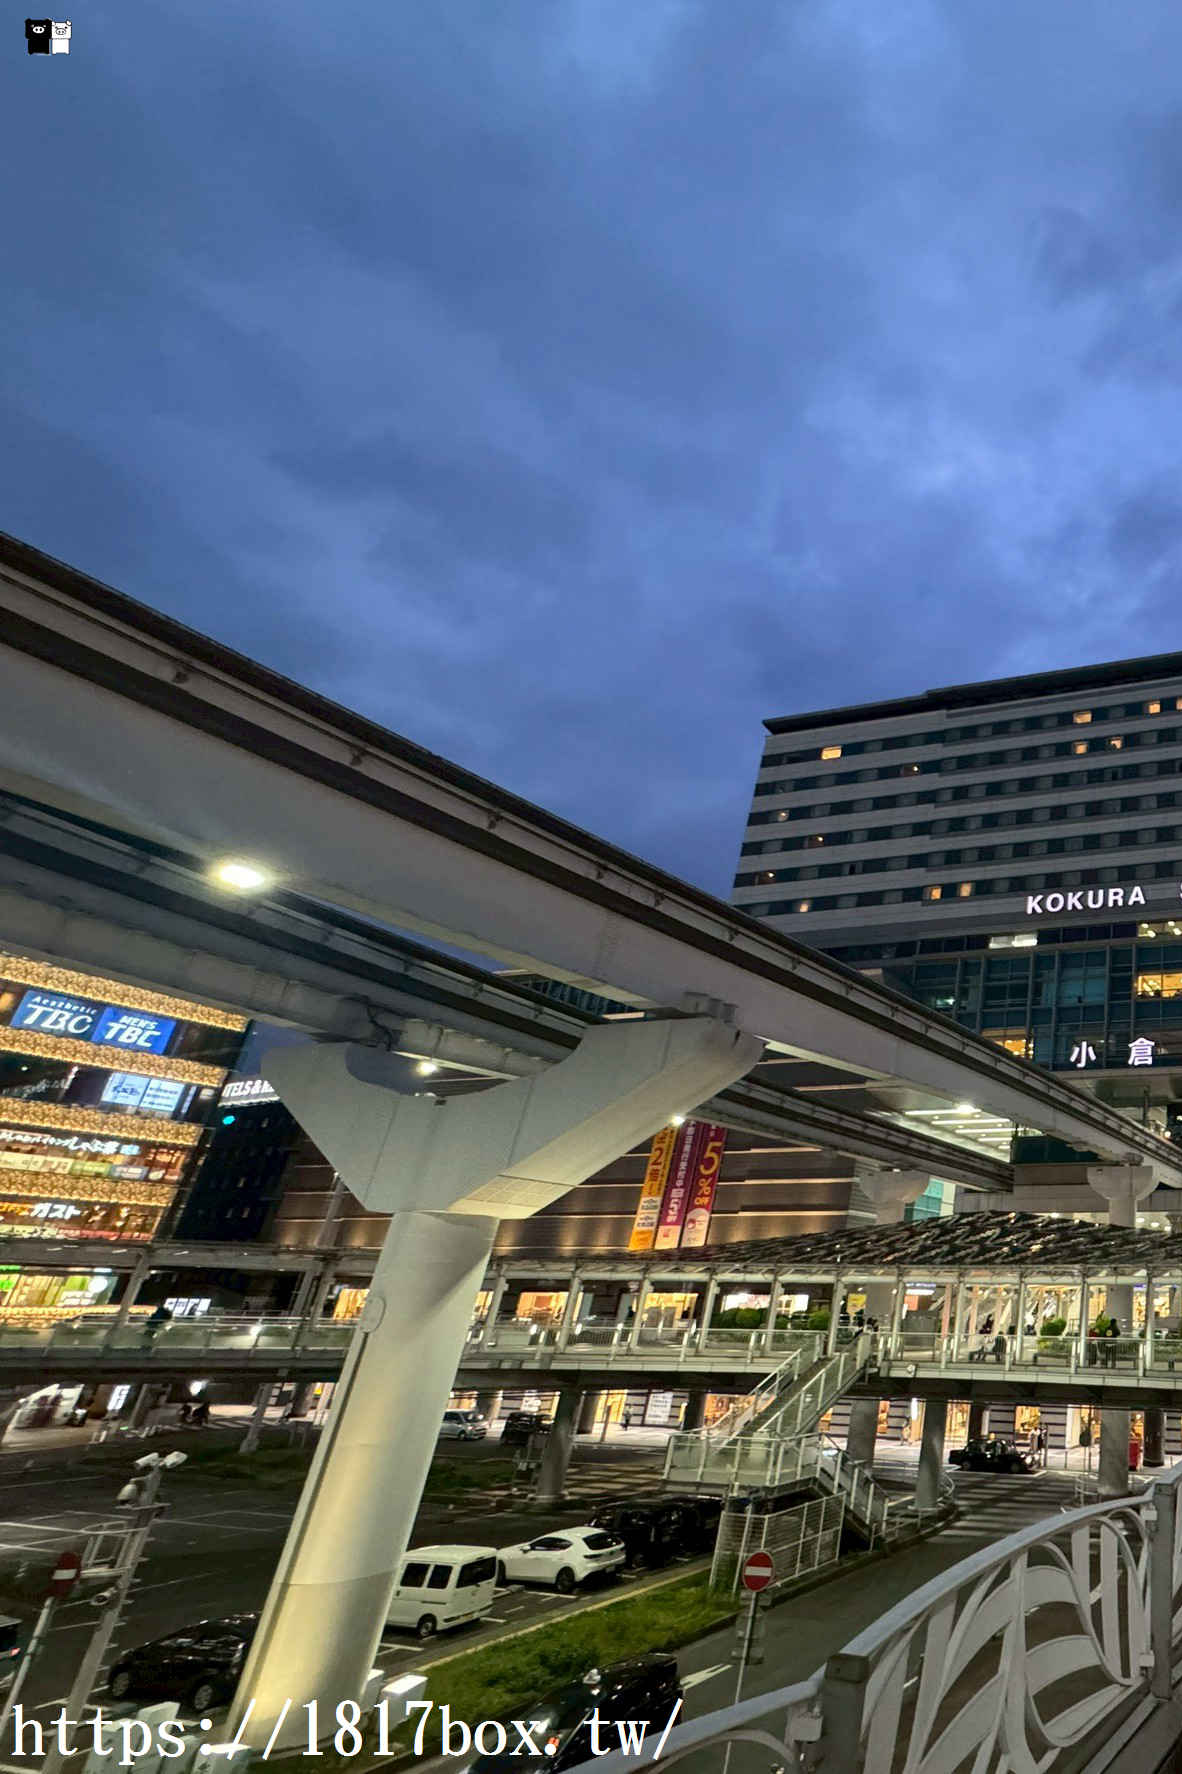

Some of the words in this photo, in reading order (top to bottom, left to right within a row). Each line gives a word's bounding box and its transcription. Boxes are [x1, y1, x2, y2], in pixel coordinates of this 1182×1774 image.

[1027, 885, 1146, 915] KOKURA
[32, 996, 98, 1015] Aesthetic
[23, 1004, 94, 1034] TBC
[104, 1022, 162, 1048] TBC
[30, 1202, 81, 1220] ガスト
